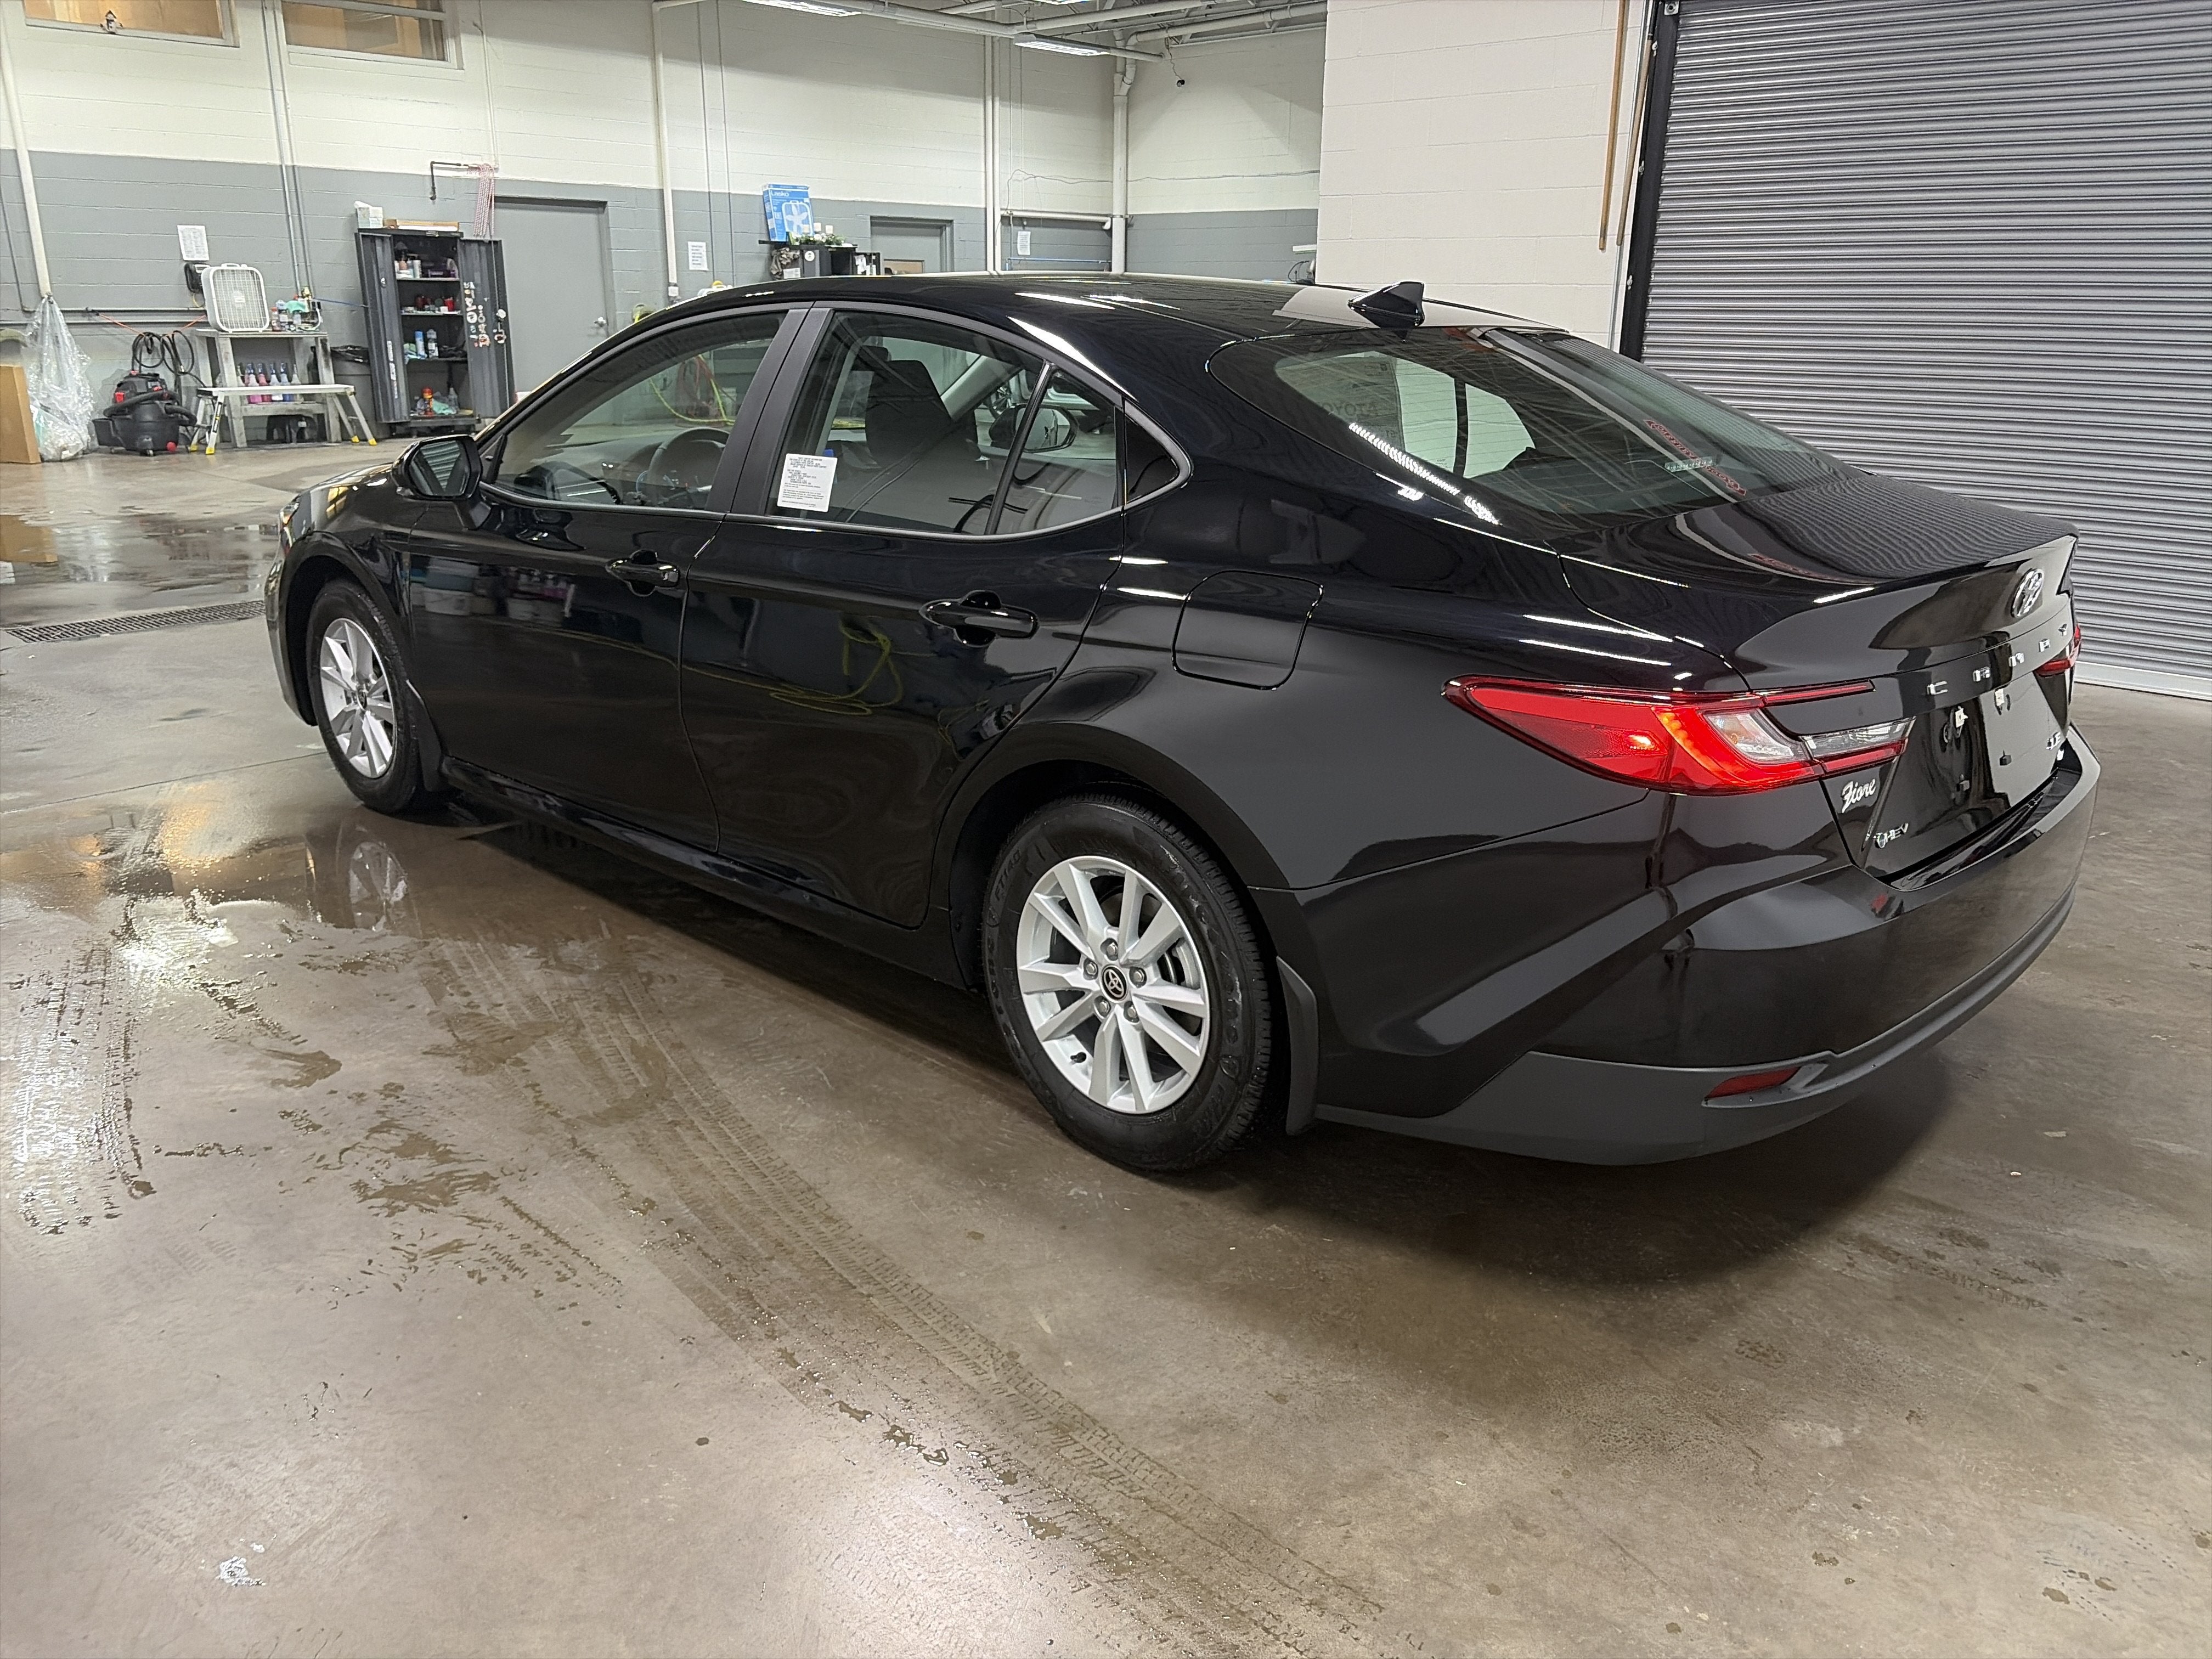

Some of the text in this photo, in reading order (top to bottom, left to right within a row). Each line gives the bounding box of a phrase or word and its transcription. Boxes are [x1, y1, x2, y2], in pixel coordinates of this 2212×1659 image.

[1927, 623, 2068, 696] CAMRY
[2046, 732, 2061, 751] LE
[1842, 778, 1876, 814] Fiore
